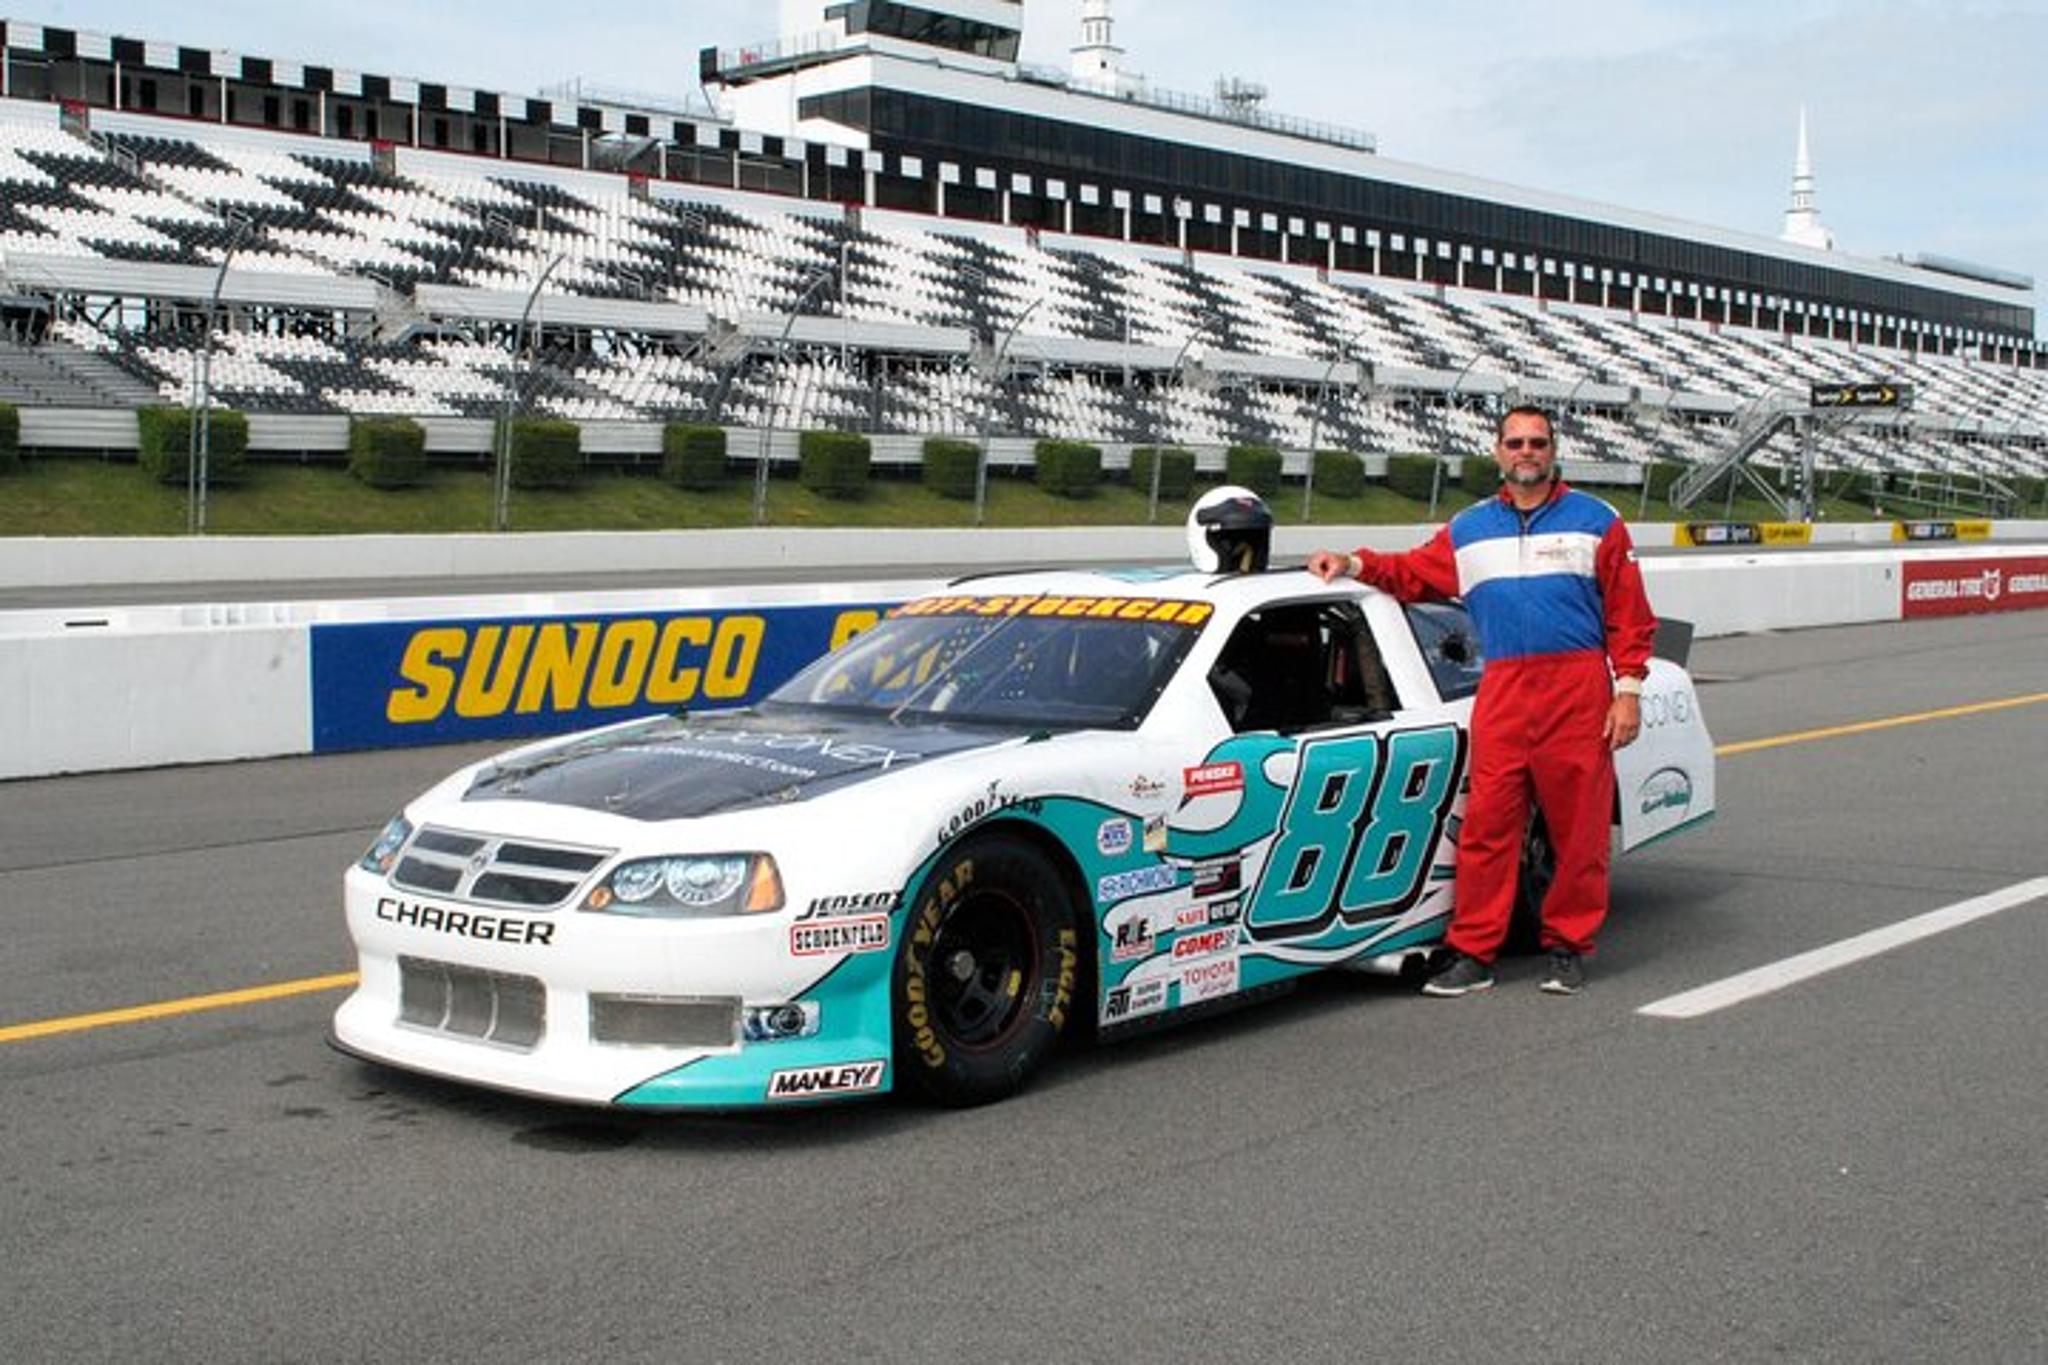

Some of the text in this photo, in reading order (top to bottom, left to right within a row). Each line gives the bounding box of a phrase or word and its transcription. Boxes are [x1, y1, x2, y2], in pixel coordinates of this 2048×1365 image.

[1907, 580, 1957, 600] GENERAL
[387, 615, 766, 723] SUNOCO
[1245, 723, 1464, 938] 88
[376, 897, 556, 946] CHARGER
[1049, 928, 1077, 1031] EAGLE
[1184, 960, 1236, 985] TOYOTA
